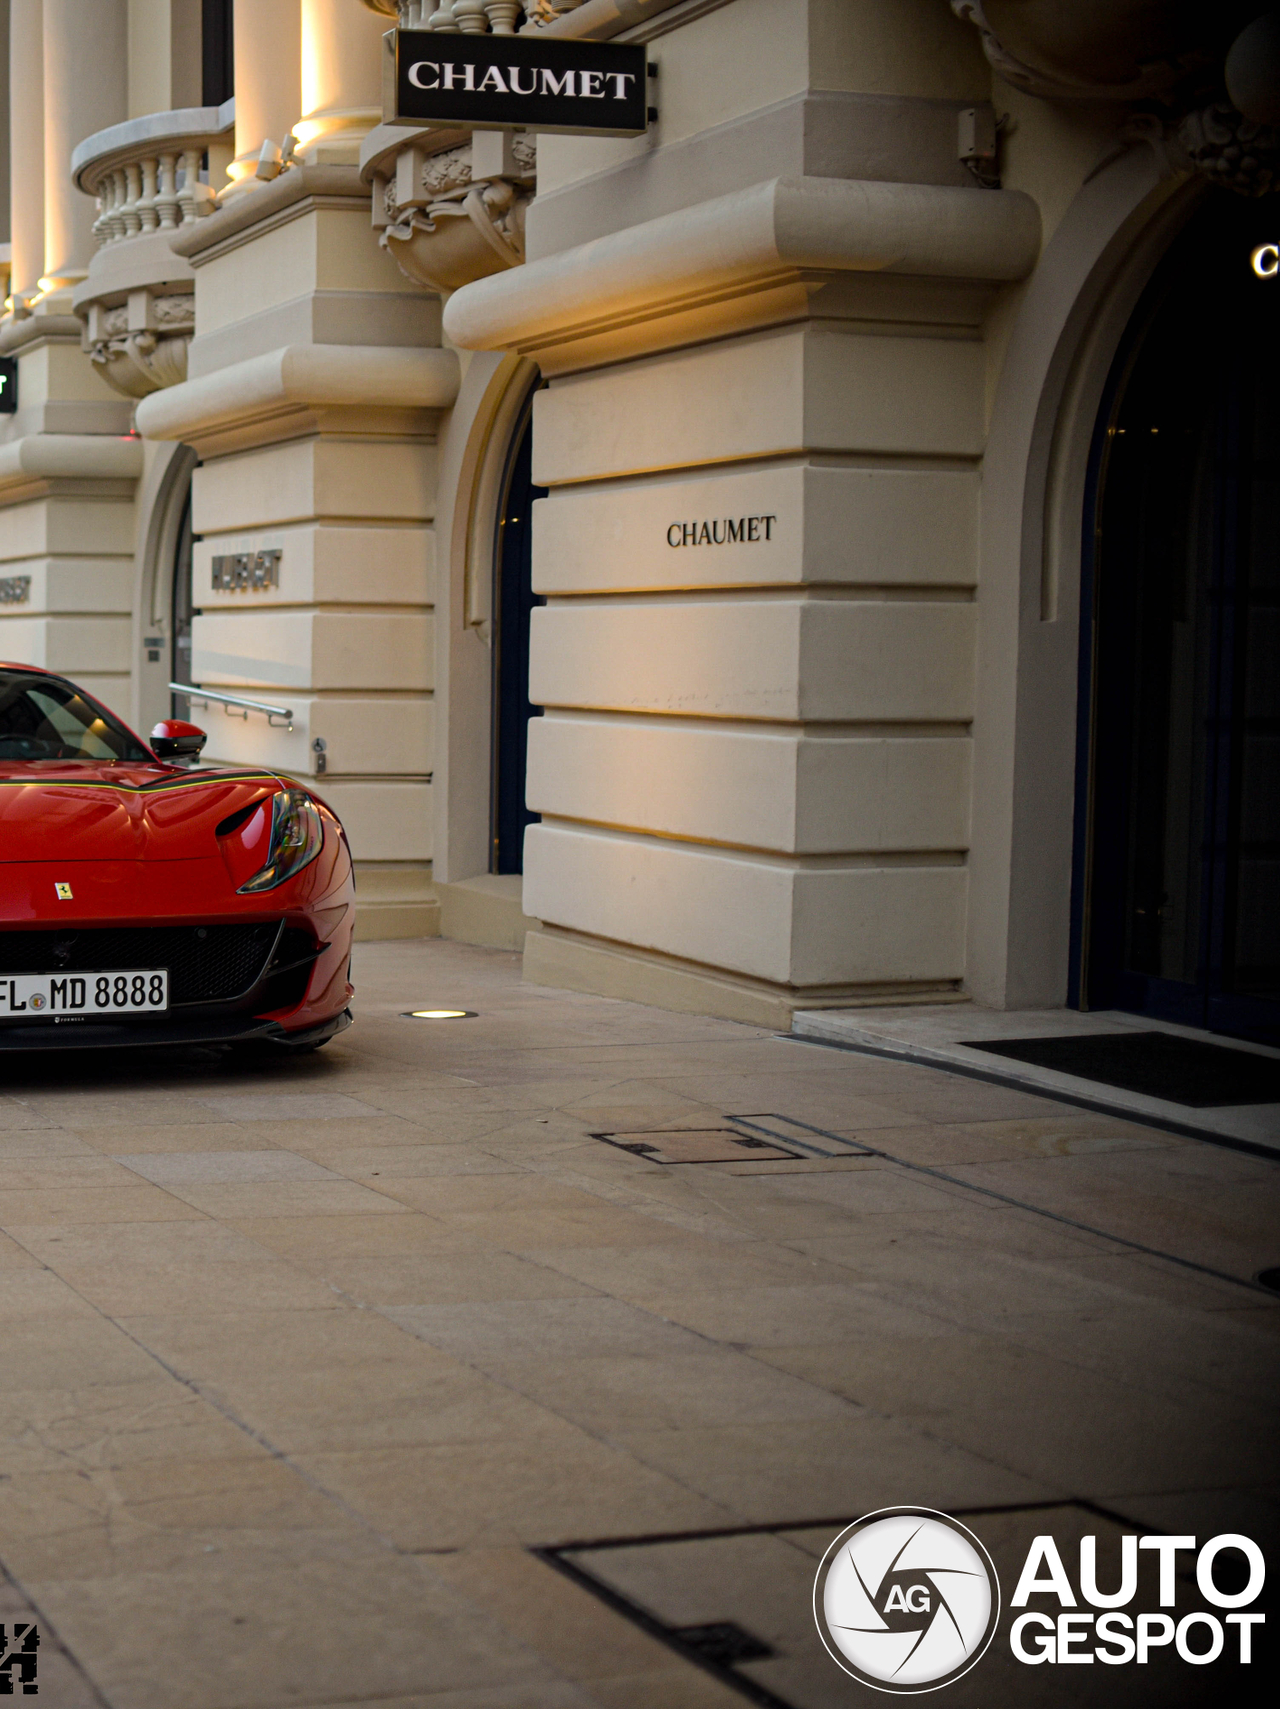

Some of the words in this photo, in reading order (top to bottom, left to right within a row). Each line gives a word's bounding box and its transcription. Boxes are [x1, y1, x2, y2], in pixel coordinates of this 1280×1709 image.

[407, 61, 636, 100] CHAUMET
[666, 515, 777, 548] CHAUMET
[50, 978, 86, 1010] MD
[94, 974, 164, 1008] 8888
